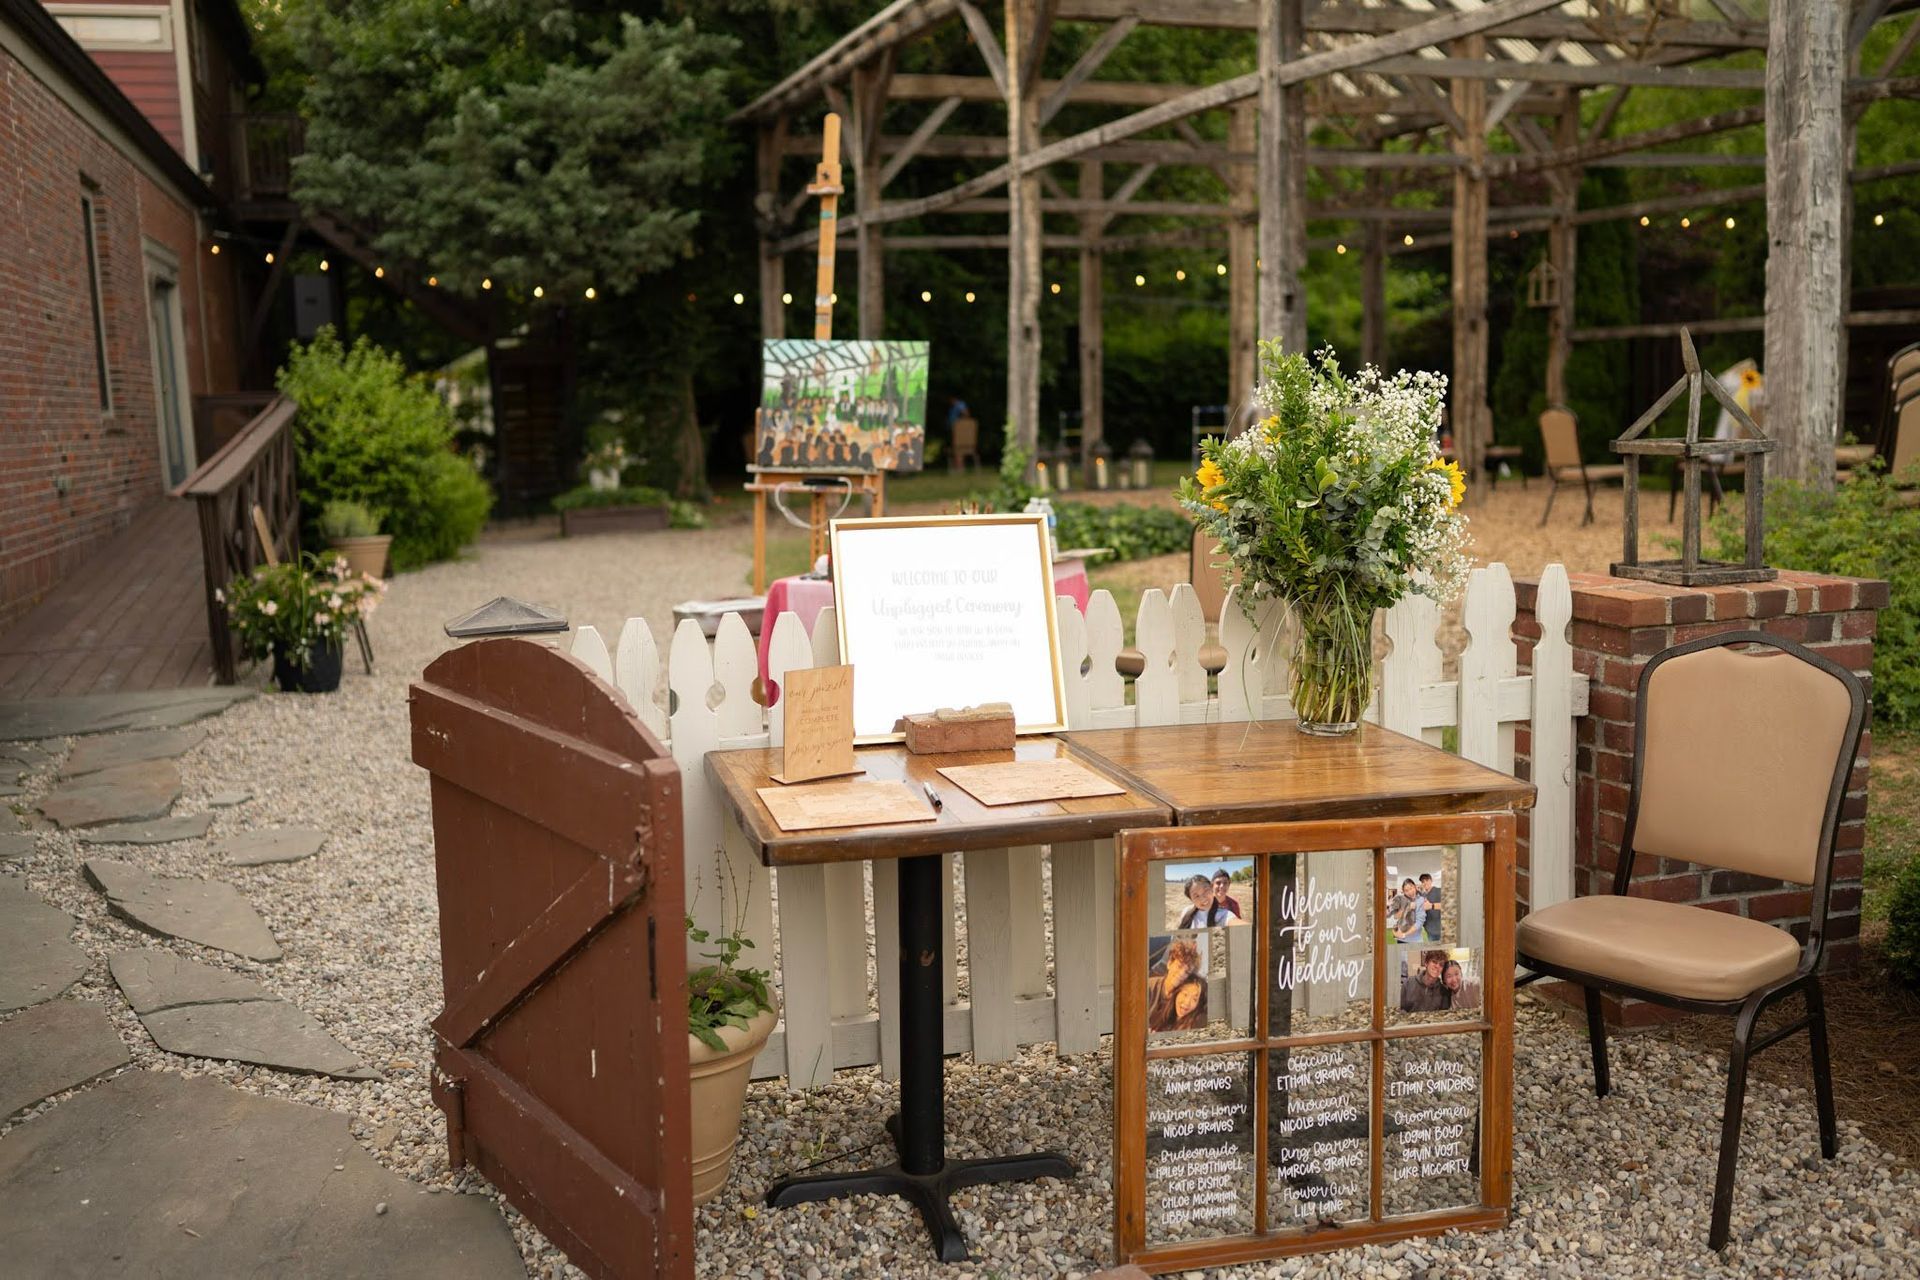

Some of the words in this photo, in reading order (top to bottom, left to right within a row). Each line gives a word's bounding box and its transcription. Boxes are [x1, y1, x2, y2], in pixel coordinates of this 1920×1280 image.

[953, 569, 967, 585] TO
[972, 568, 998, 584] OUR
[872, 597, 952, 620] Unplugged
[955, 596, 1022, 618] Ceremony
[1281, 876, 1360, 920] Welcome
[1280, 919, 1318, 952] to
[1319, 925, 1362, 943] our
[1278, 944, 1365, 998] Wedding
[1153, 1061, 1187, 1078] Maid
[1188, 1061, 1204, 1076] of
[1206, 1060, 1245, 1072] Honor
[1405, 1060, 1432, 1077] Best
[1434, 1060, 1464, 1074] Man
[1149, 1108, 1194, 1123] Matron
[1195, 1105, 1209, 1119] of
[1211, 1103, 1247, 1116] Honor
[1394, 1105, 1470, 1126] Groomsmen
[1160, 1141, 1238, 1163] Bridesmaids
[1281, 1146, 1311, 1163] Ring
[1313, 1137, 1360, 1156] Bearer
[1283, 1185, 1328, 1202] Flower
[1329, 1180, 1358, 1197] Girl
